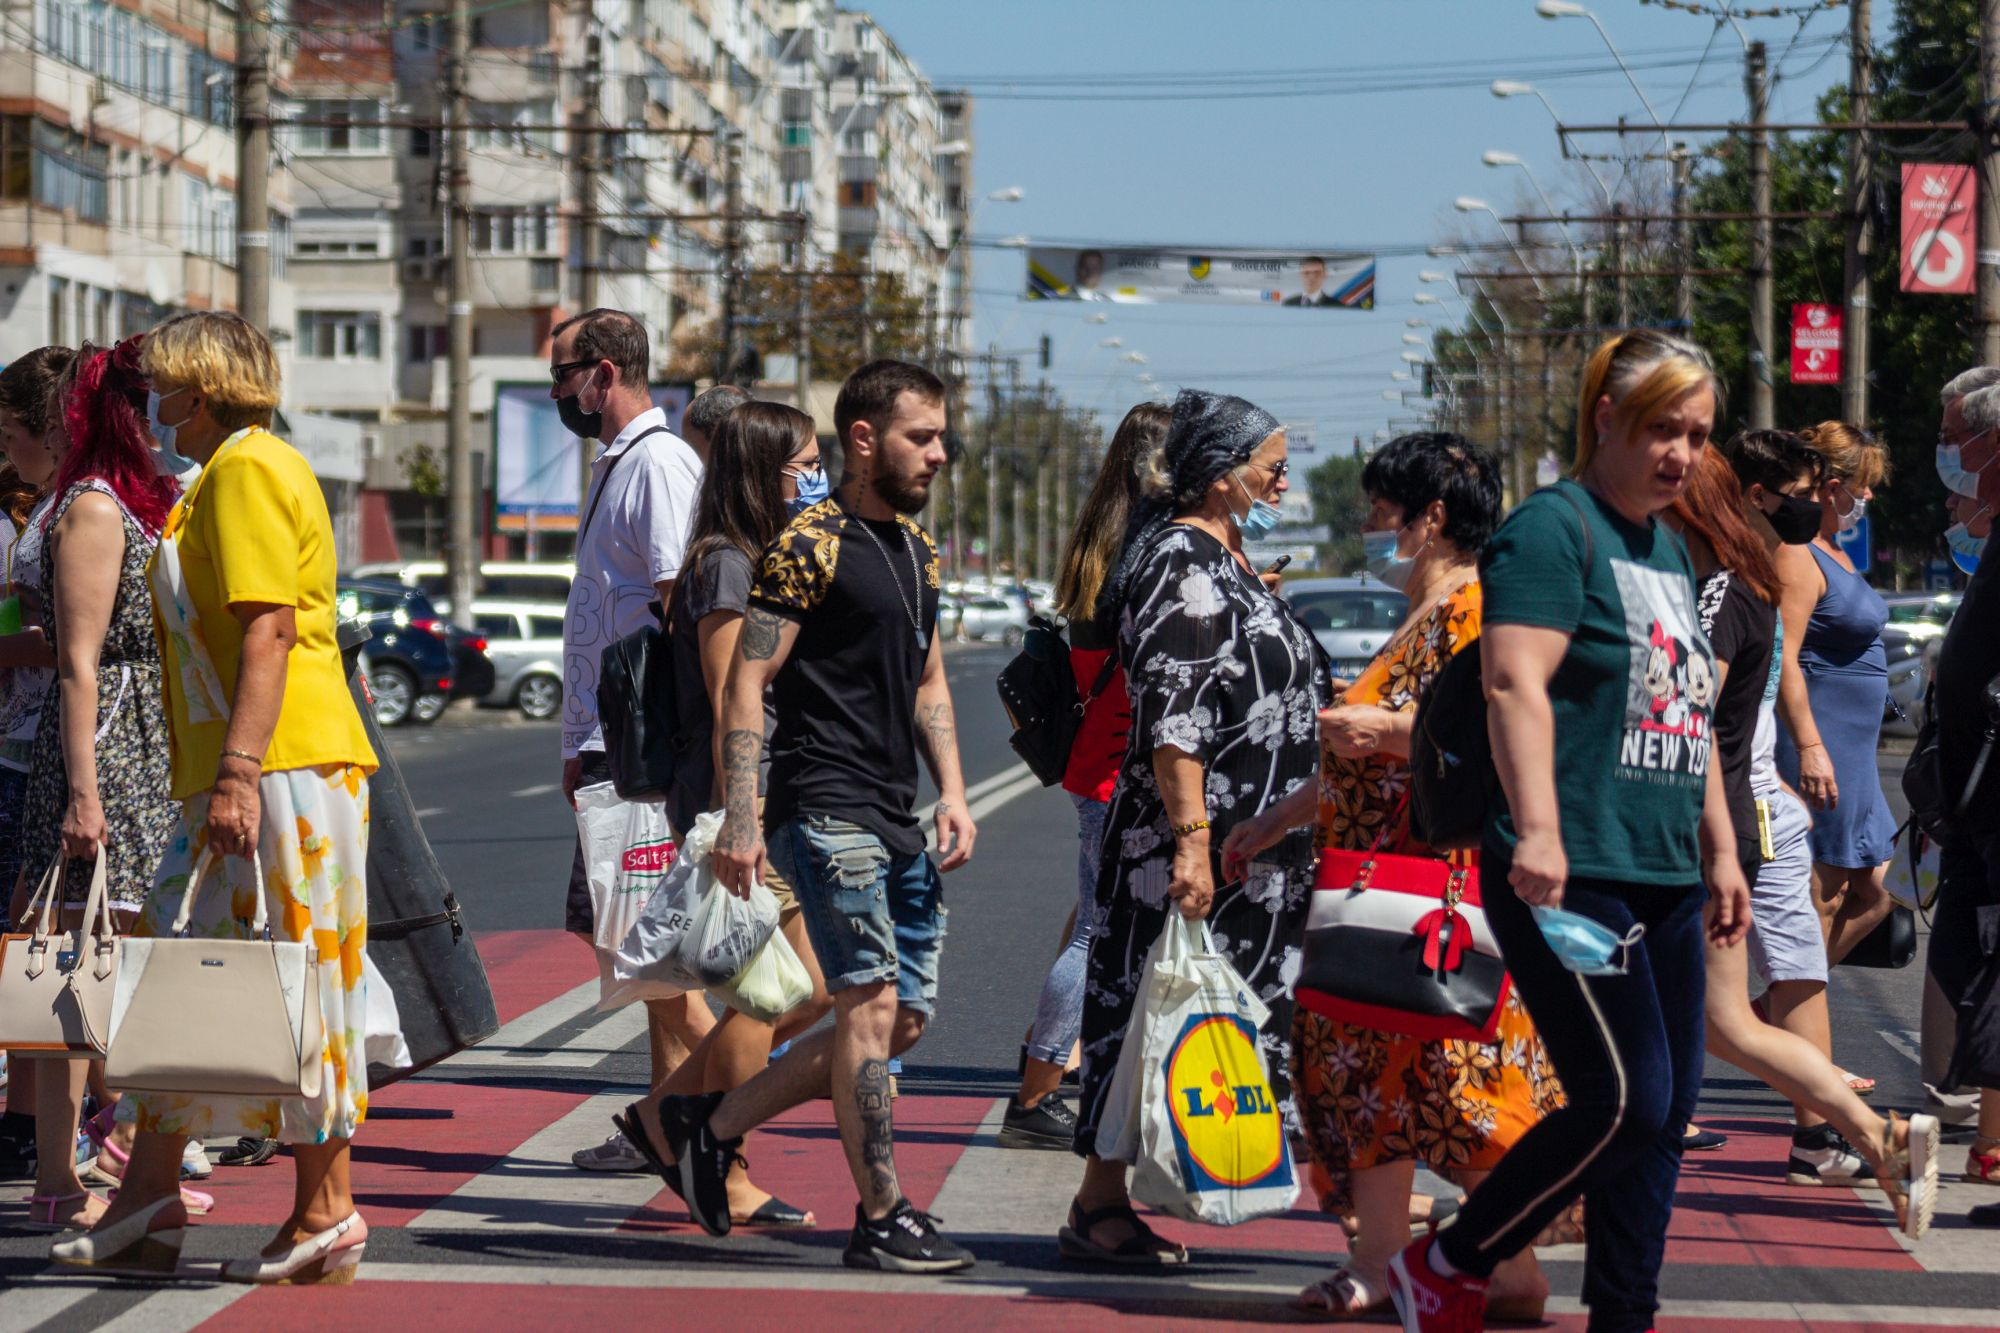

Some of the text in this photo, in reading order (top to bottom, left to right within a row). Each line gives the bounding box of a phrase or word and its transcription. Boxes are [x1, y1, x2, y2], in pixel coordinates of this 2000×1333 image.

[1621, 729, 1680, 771] NEW
[1648, 770, 1676, 787] YOUR
[1182, 1069, 1272, 1123] LIDL
